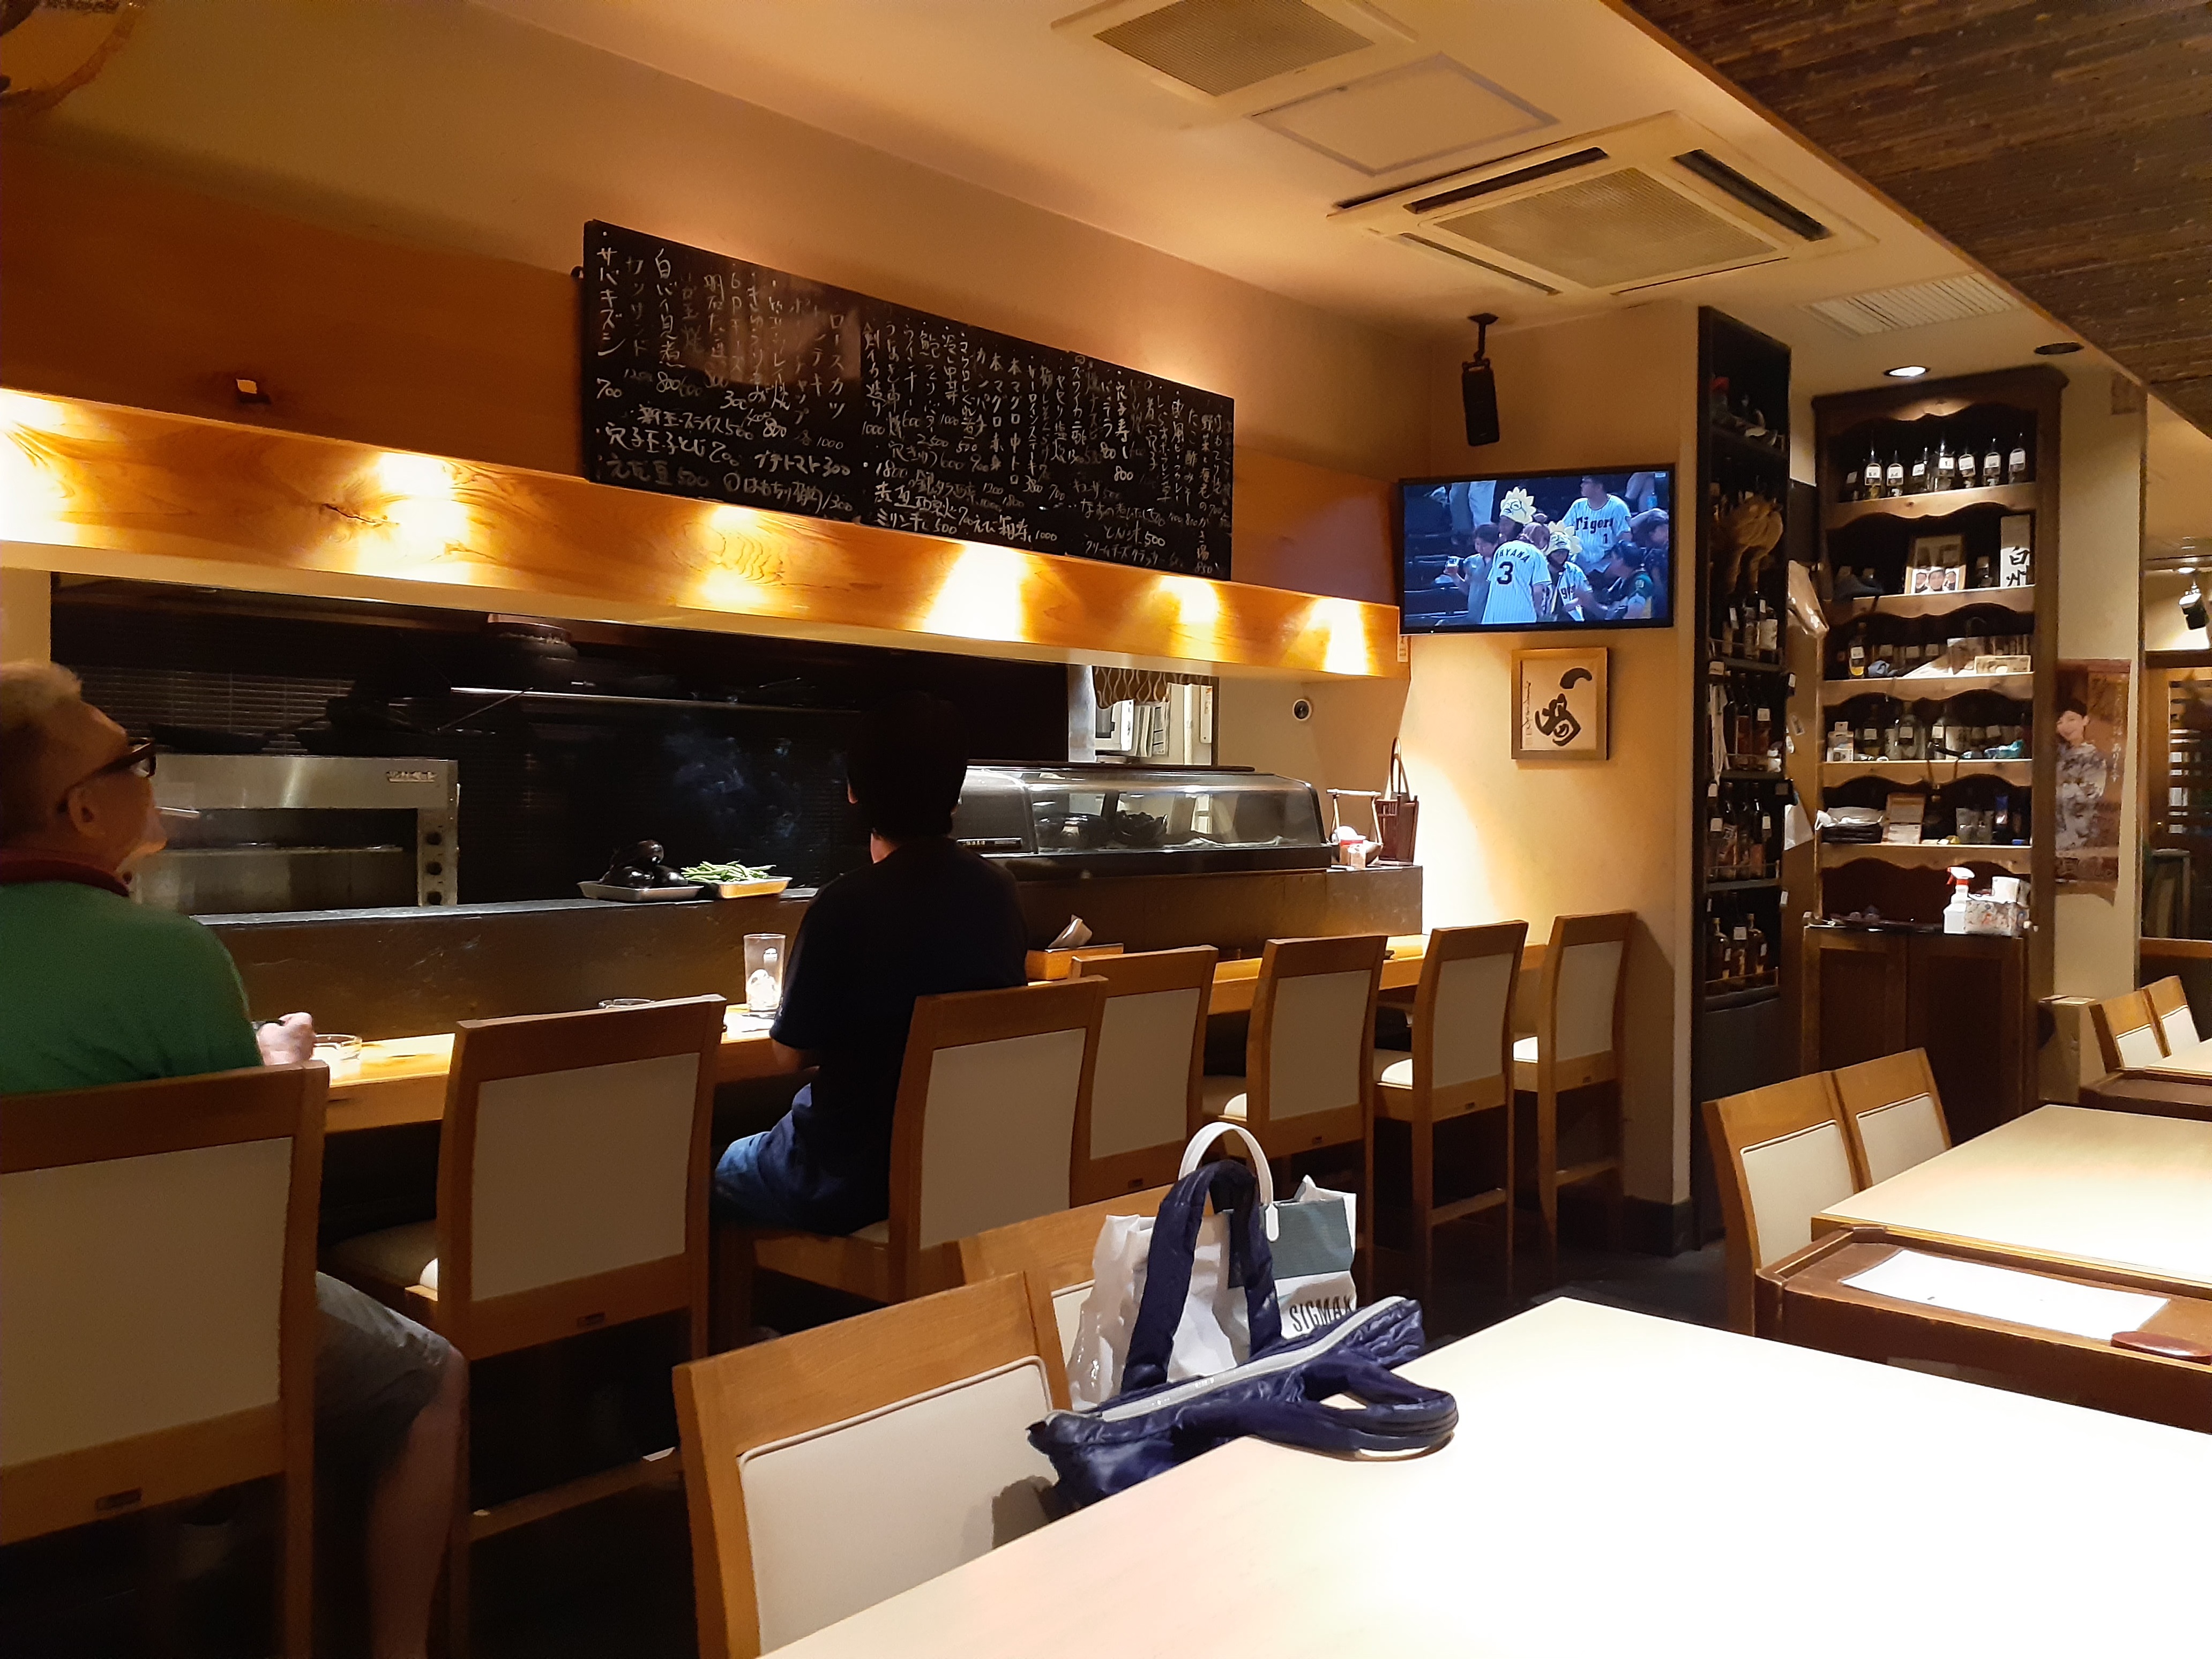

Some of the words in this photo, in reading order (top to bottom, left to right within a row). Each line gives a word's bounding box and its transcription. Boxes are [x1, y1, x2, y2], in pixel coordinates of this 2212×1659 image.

[829, 313, 846, 420] ロースカツ
[596, 378, 623, 400] 700
[719, 390, 749, 411] 300
[724, 417, 755, 441] 500
[762, 417, 787, 438] 800
[861, 420, 885, 437] 1000
[939, 412, 960, 427] 1000
[1007, 357, 1023, 485] 本マグロ中トロ
[1114, 380, 1131, 460] 穴子寿し
[816, 436, 845, 451] 1000
[955, 440, 978, 455] 500
[1099, 440, 1117, 460] 800
[821, 456, 851, 479] 300
[940, 451, 965, 471] 600
[1113, 465, 1134, 482] 800
[1048, 483, 1066, 502] 700
[934, 517, 958, 536] 500
[1034, 528, 1058, 542] 1000
[1145, 530, 1166, 547] 500
[1496, 561, 1513, 585] 3
[2006, 545, 2030, 587] 白州
[1289, 1294, 1354, 1332] SIGMAX
